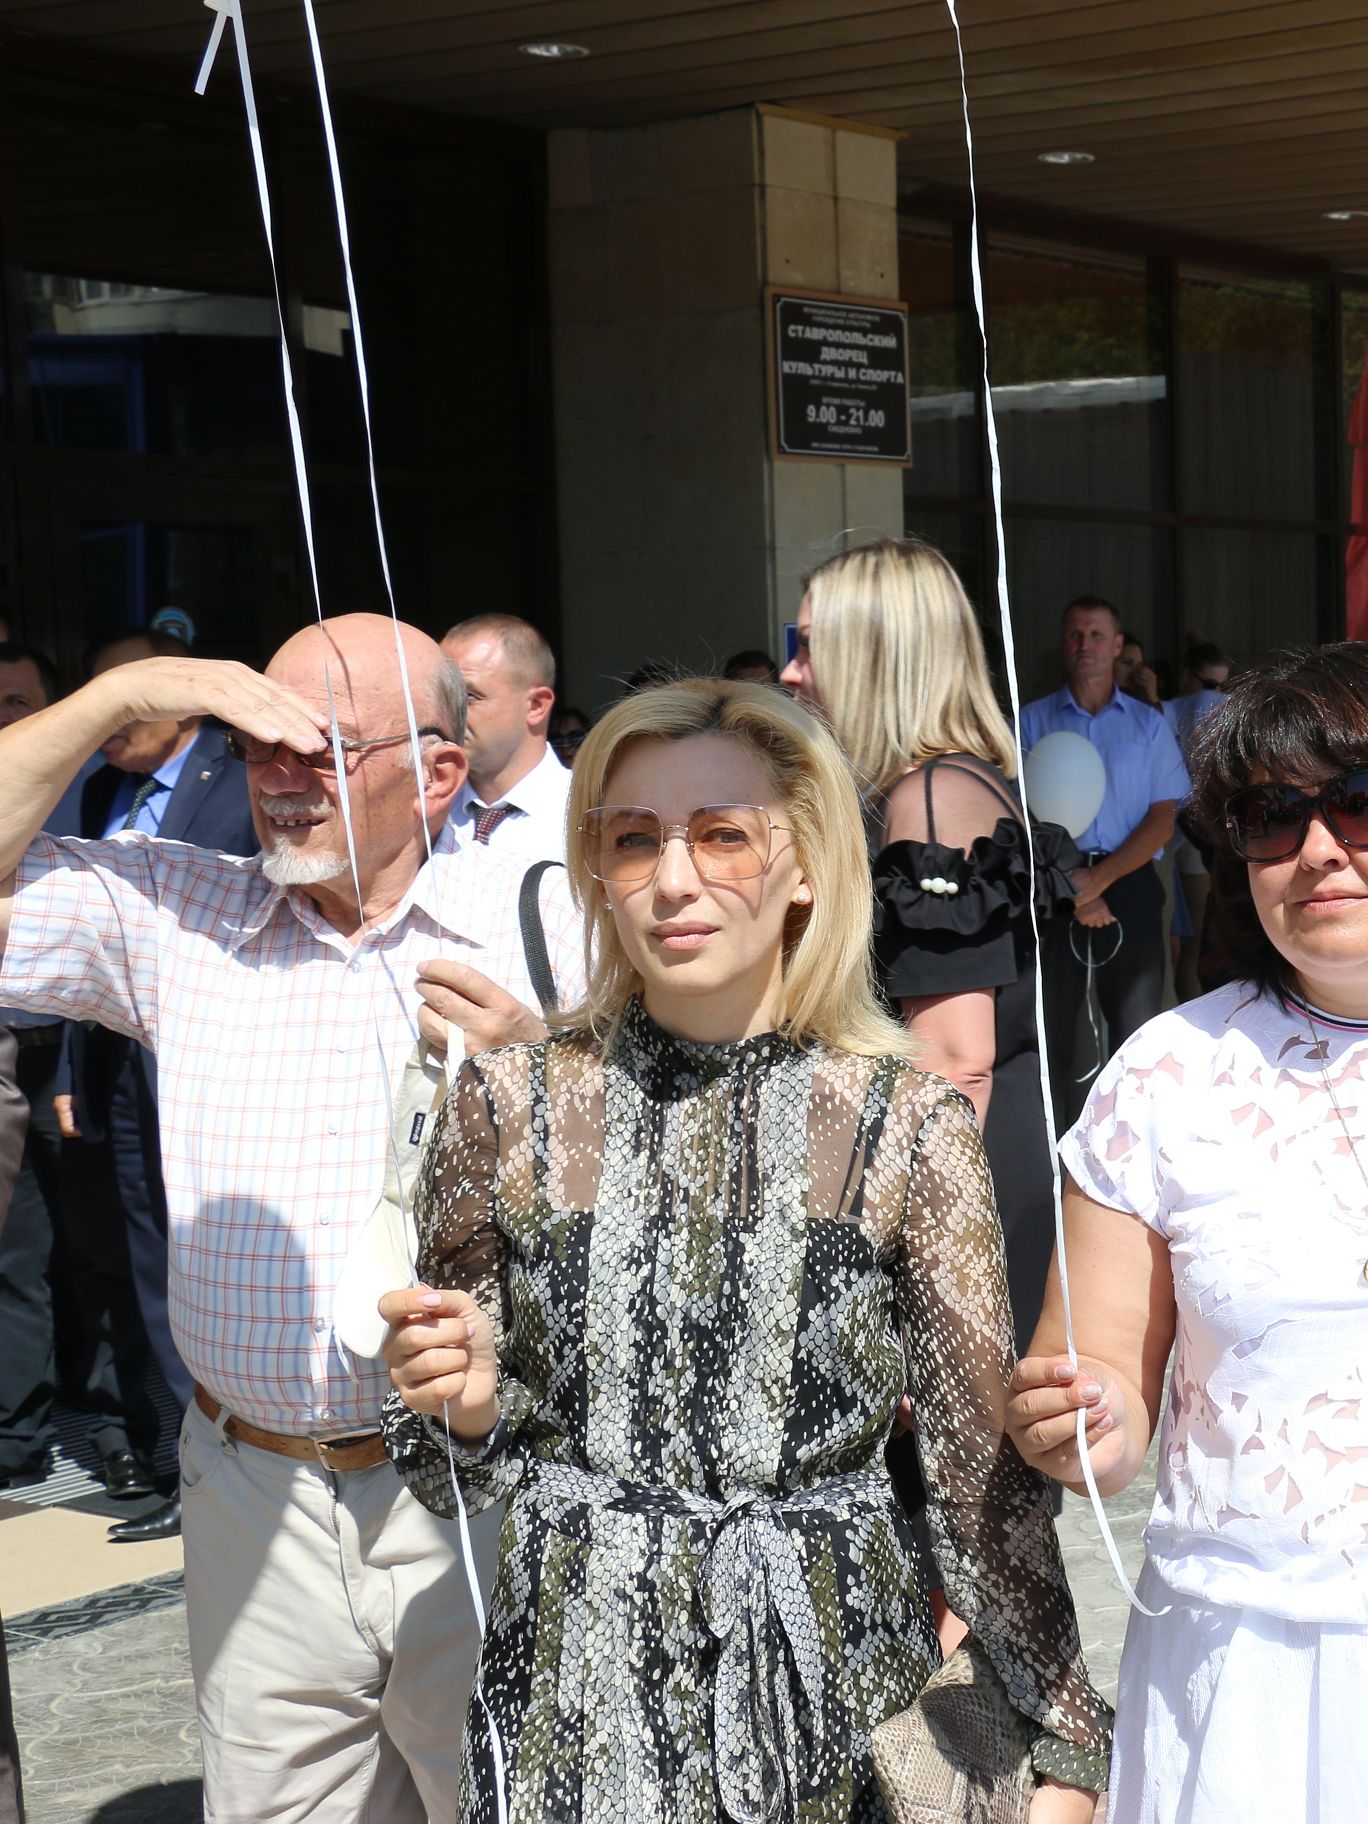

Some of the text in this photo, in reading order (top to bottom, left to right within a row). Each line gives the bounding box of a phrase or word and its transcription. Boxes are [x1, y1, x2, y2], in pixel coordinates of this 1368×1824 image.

[787, 324, 897, 349] СТАВРОПОЛЬСКИЙ
[820, 346, 868, 365] ДВОРЕЦ
[782, 361, 845, 379] КУЛЬТУРЫ
[848, 367, 857, 380] И
[859, 369, 905, 384] СПОРТА
[806, 404, 837, 423] 9.00
[849, 408, 885, 428] 21.00
